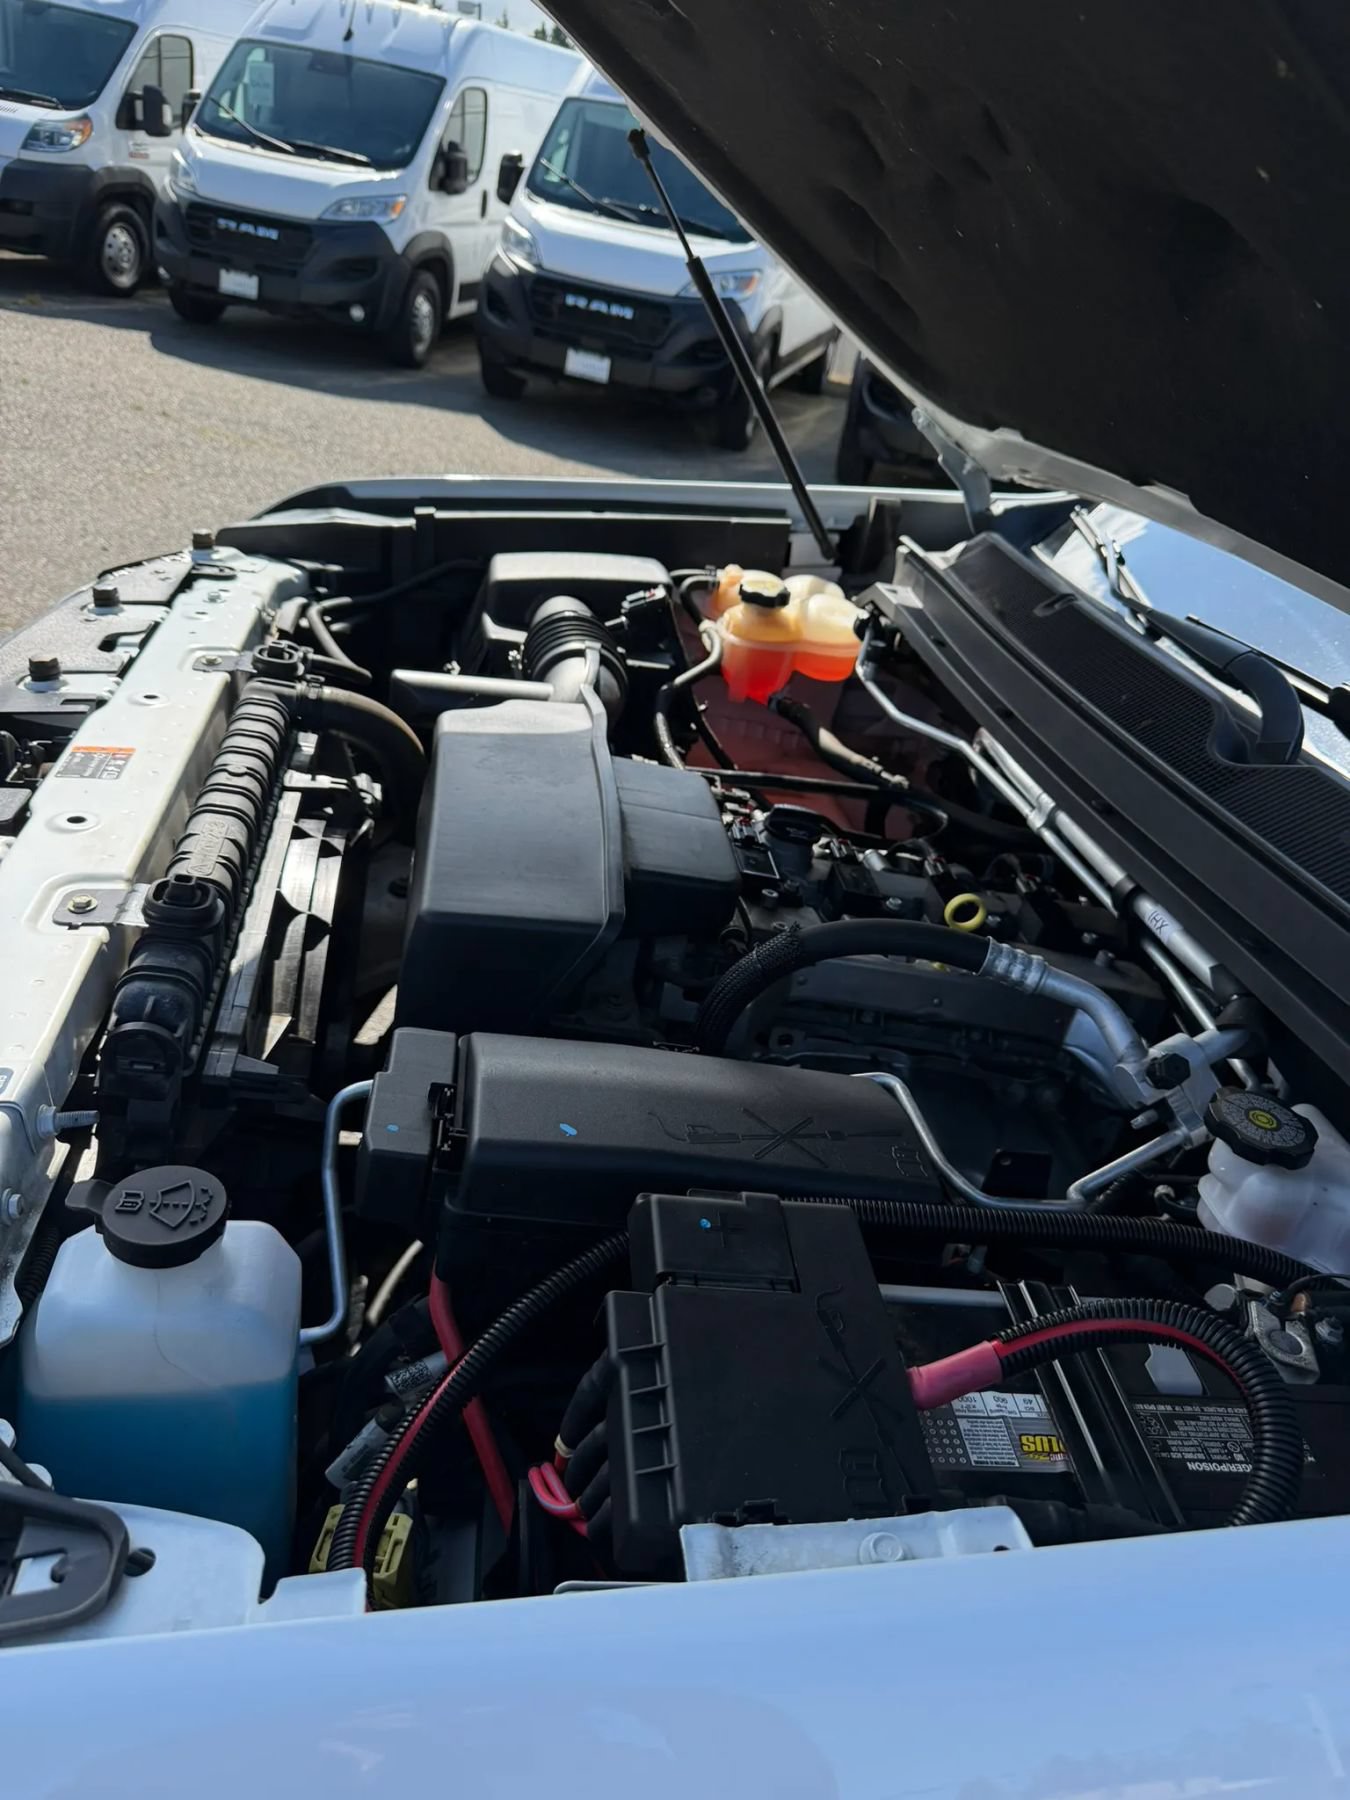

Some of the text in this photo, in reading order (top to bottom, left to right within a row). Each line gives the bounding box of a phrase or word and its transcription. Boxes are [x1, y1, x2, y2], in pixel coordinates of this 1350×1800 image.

[217, 218, 279, 240] RAM
[565, 293, 634, 320] RAM
[1020, 1435, 1064, 1453] LUS
